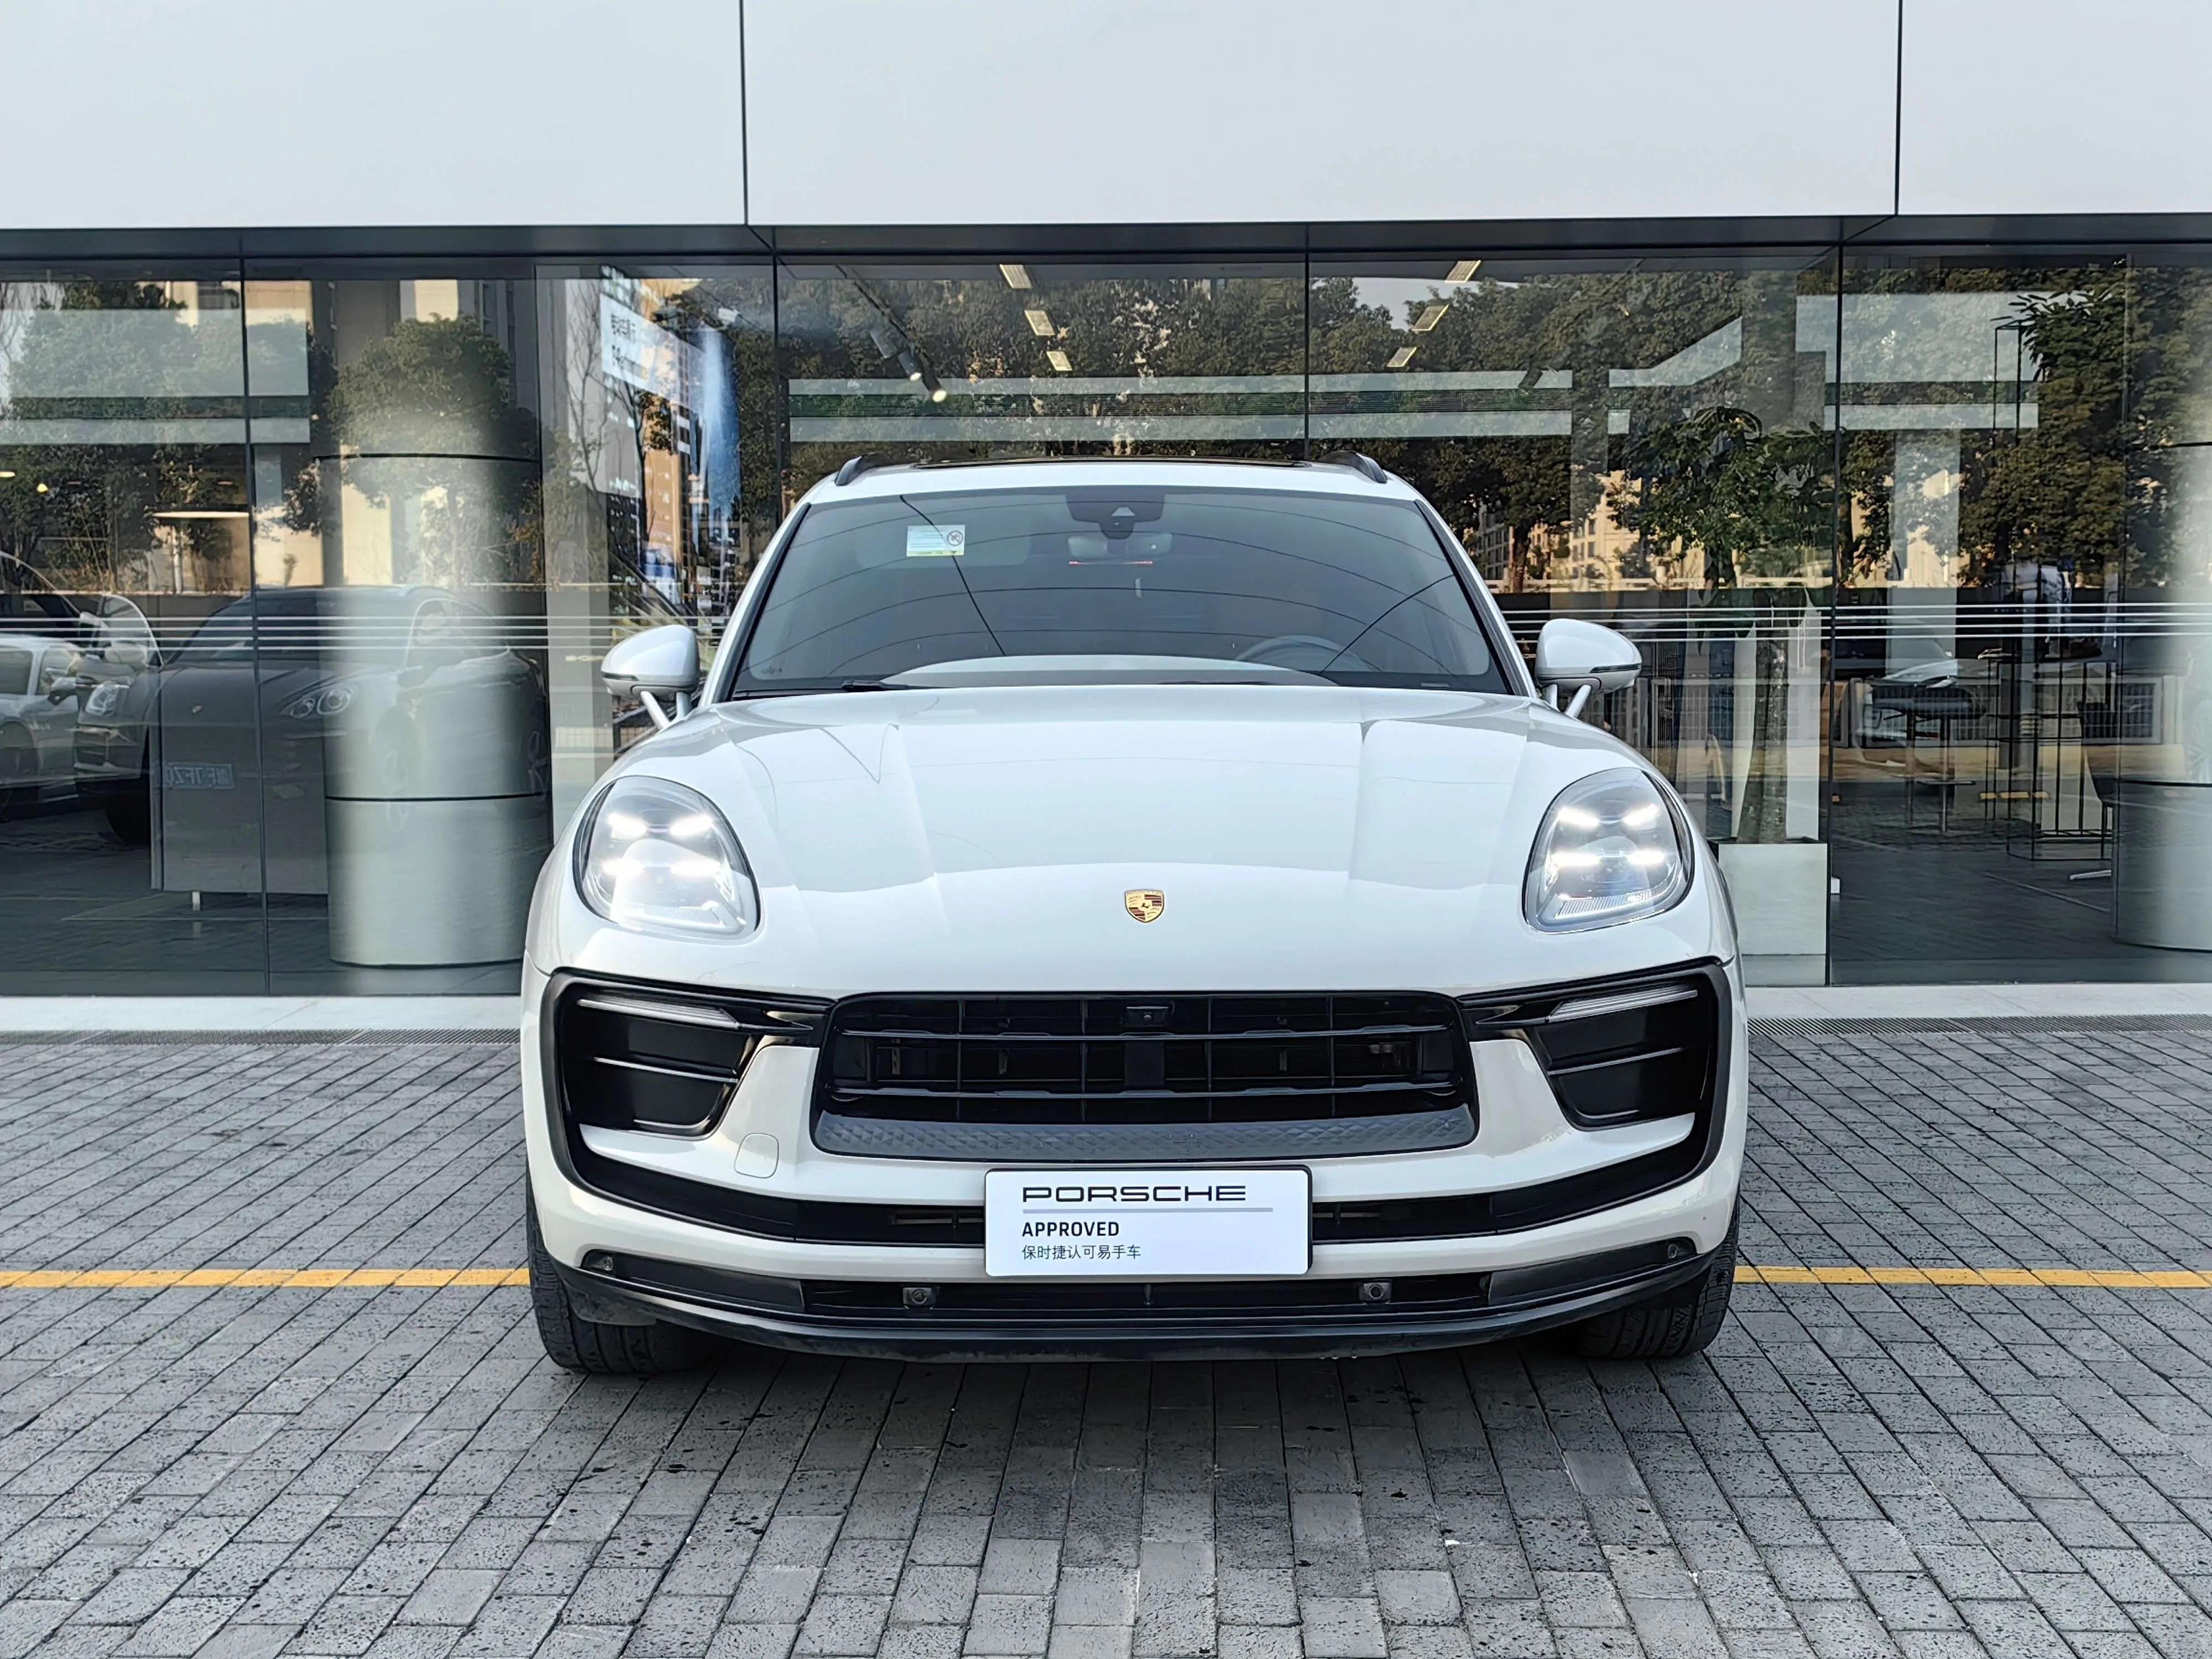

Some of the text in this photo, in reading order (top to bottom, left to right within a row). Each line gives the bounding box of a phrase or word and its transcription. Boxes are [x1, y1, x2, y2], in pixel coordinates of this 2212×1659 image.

[1022, 1185, 1246, 1202] PORSCHE
[1022, 1221, 1119, 1237] APPROVED
[1021, 1244, 1141, 1260] 保时捷认可易手车
